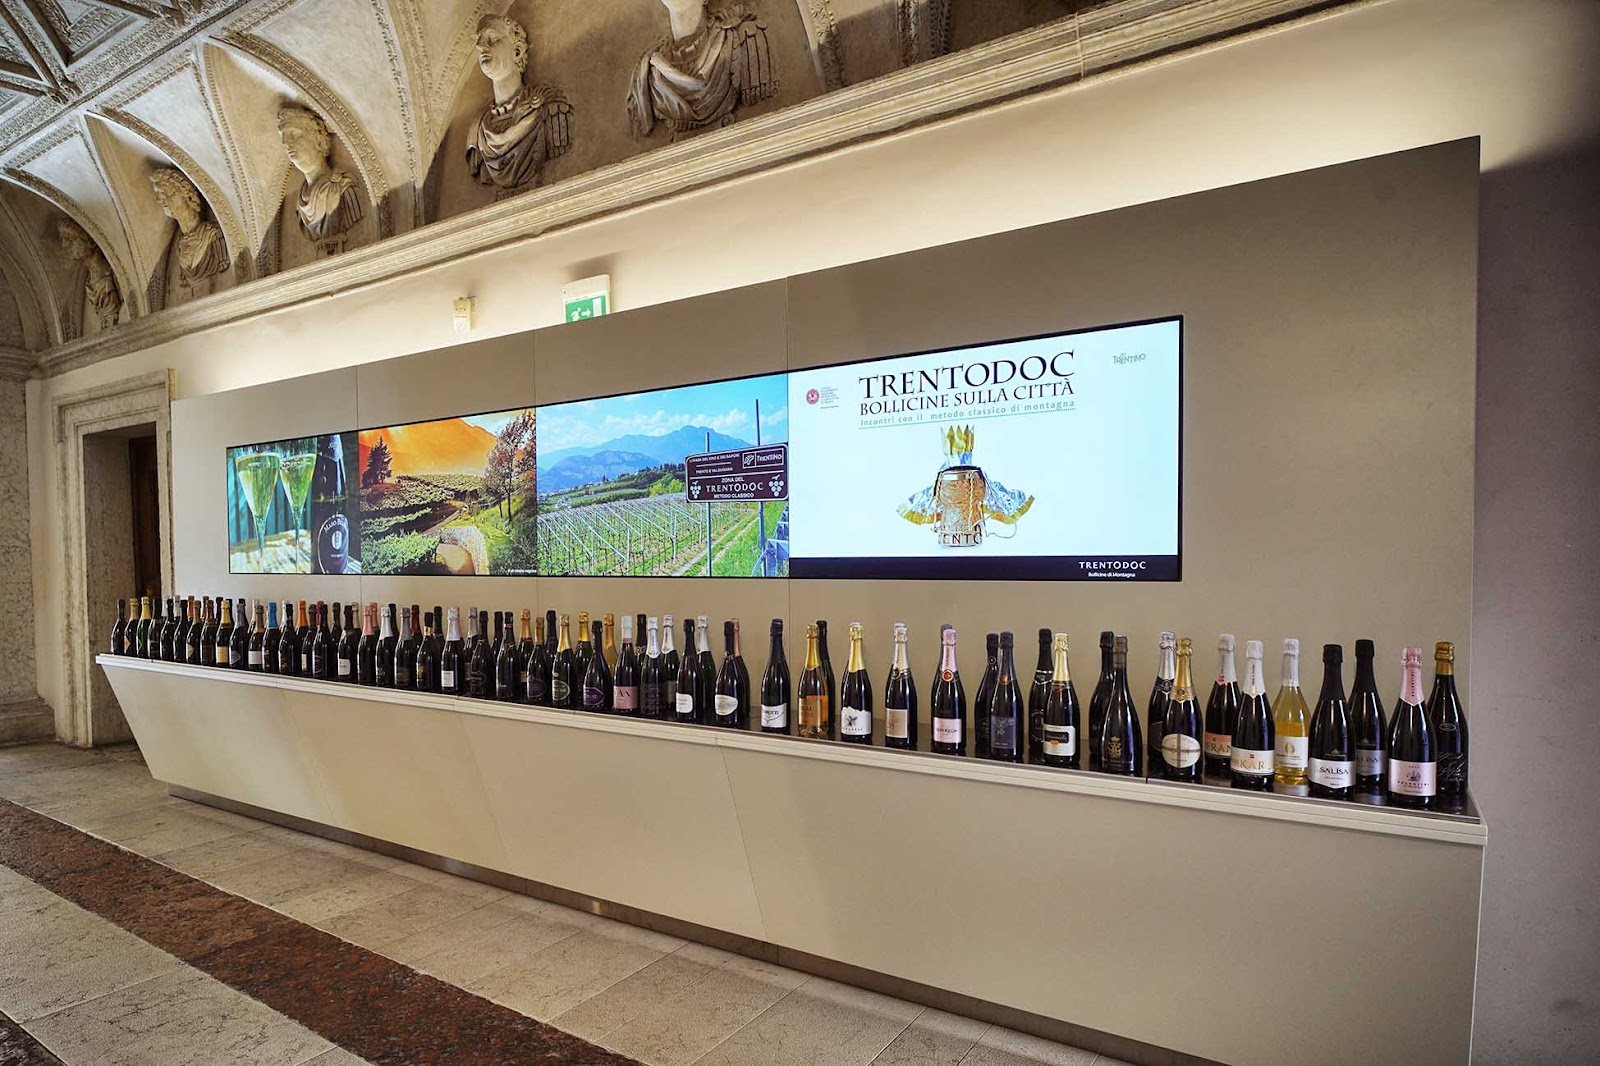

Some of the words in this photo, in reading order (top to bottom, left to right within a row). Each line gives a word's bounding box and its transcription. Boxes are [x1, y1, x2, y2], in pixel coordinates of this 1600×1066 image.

[859, 349, 1075, 399] TRENTODOC
[859, 394, 949, 416] BOLLICINE
[954, 388, 1008, 407] SULLA
[1013, 378, 1075, 401] CITTÀ
[860, 416, 895, 426] Incontri
[898, 415, 913, 423] con
[930, 410, 964, 420] metodo
[968, 407, 1006, 416] classico
[1011, 404, 1020, 412] di
[1024, 401, 1075, 411] montagna
[706, 482, 764, 493] TRENTODOC
[1079, 561, 1146, 570] TRENTODOC
